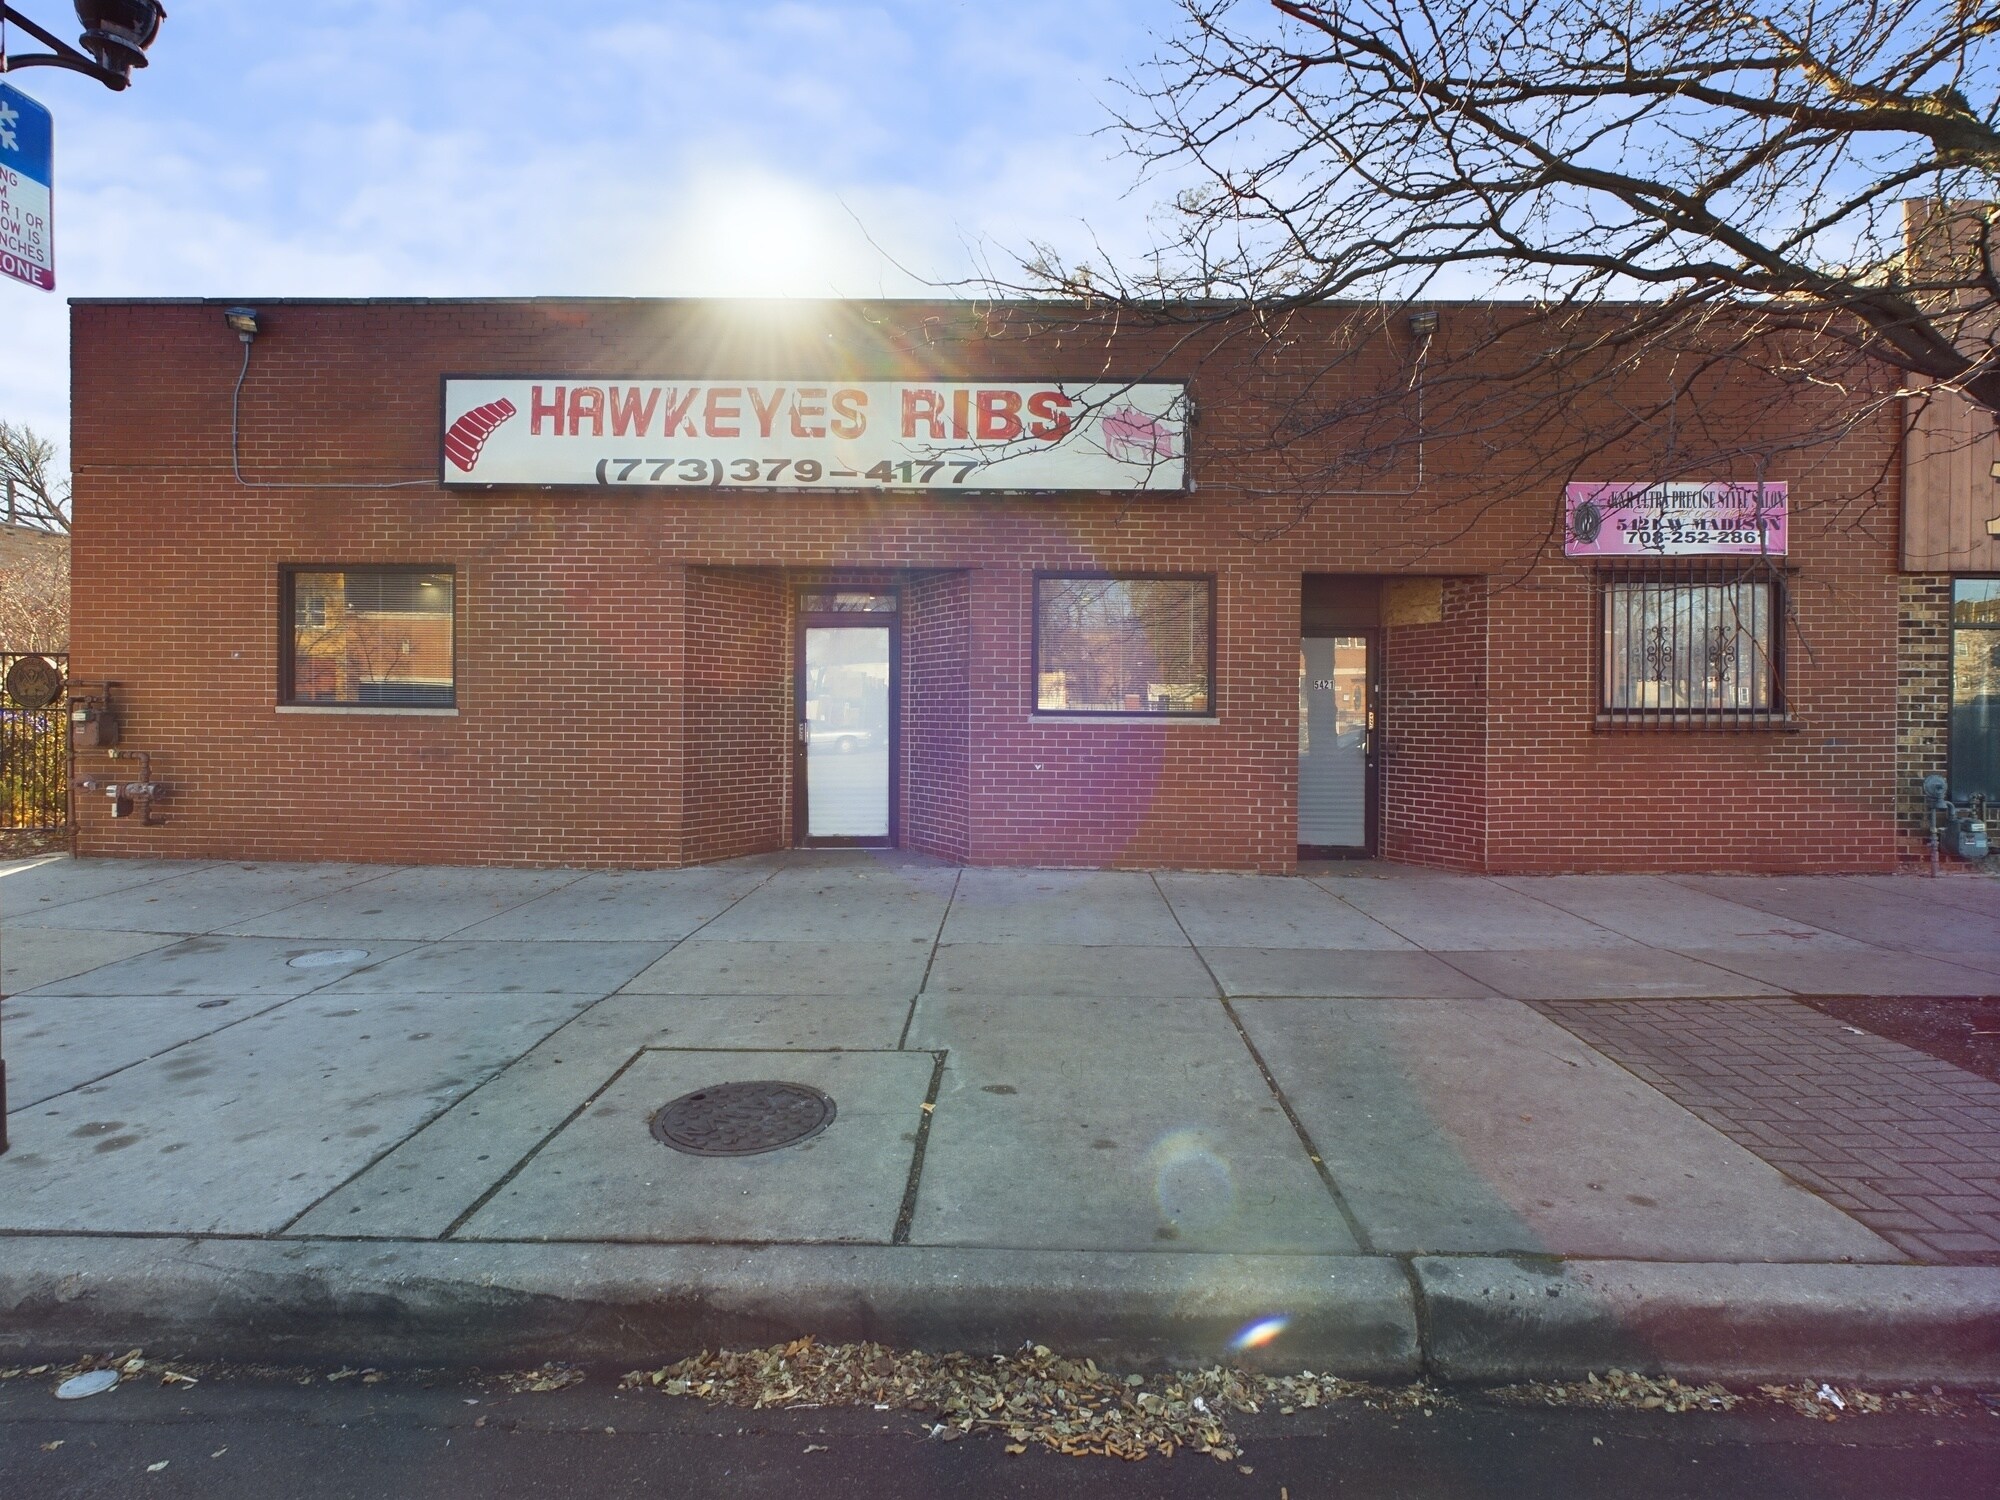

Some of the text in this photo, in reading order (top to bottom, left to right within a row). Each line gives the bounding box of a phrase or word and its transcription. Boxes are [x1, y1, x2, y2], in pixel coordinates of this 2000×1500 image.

[25, 212, 44, 232] OR
[28, 229, 41, 245] IS
[0, 252, 44, 286] ONE
[530, 385, 1073, 441] HAWKEYES RIBS
[1672, 491, 1716, 509] PRECISE
[1717, 491, 1748, 509] STYLE
[1667, 518, 1686, 531] W
[1626, 531, 1763, 544] 708-252-286
[1314, 680, 1334, 690] 5421
